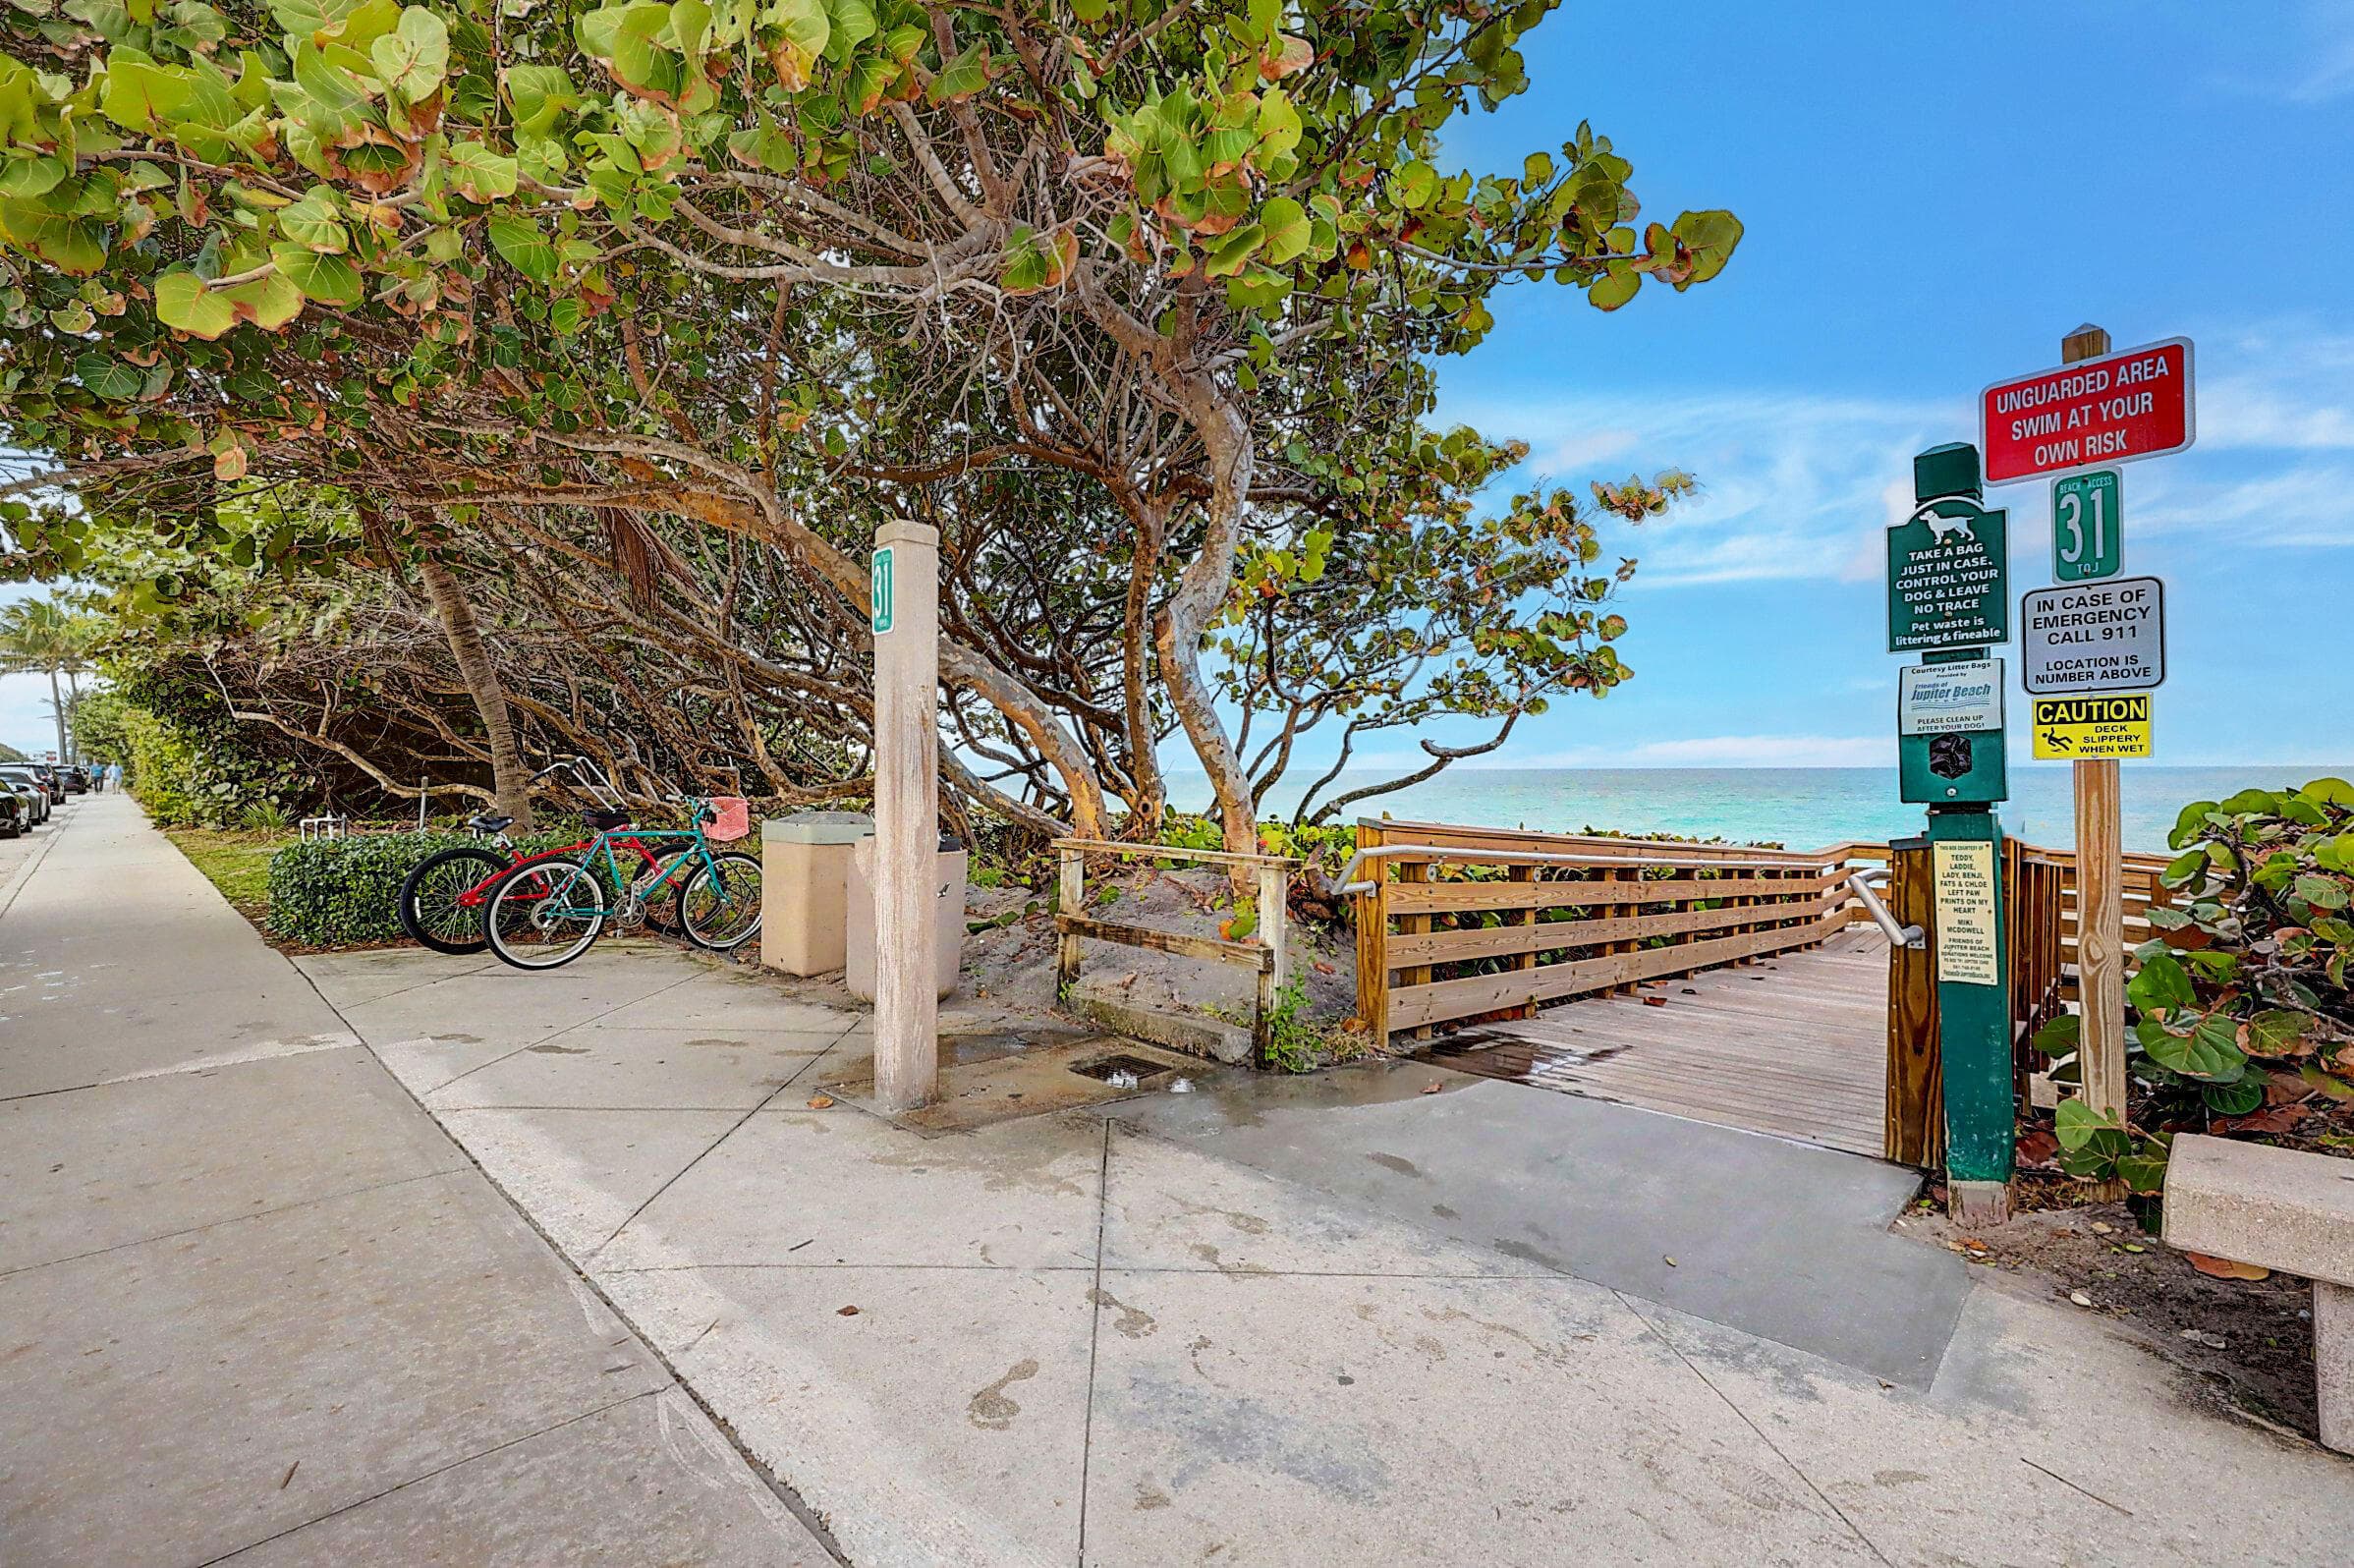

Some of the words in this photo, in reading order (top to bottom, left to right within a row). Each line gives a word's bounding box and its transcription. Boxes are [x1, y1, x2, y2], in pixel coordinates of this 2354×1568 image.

[1996, 370, 2109, 414] UNGUARDED
[2116, 356, 2169, 387] AREA
[2012, 412, 2061, 441] SWIM
[2067, 405, 2092, 429] AT
[2099, 393, 2153, 421] YOUR
[2034, 439, 2079, 466] OWN
[2086, 429, 2127, 457] RISK
[2060, 482, 2081, 494] BEACH
[2087, 476, 2112, 488] ACCESS
[2059, 488, 2104, 562] 31
[1909, 549, 1941, 561] TAKE
[1944, 548, 1953, 557] A
[1956, 543, 1983, 555] BAG
[1901, 564, 1933, 576] JUST
[1937, 561, 1950, 571] IN
[1953, 556, 1992, 569] CASE.
[1896, 575, 1957, 589] CONTROL
[1961, 569, 1998, 581] YOUR
[874, 562, 889, 618] 31
[1905, 590, 1932, 602] DOG
[1935, 589, 1945, 598] &
[1949, 584, 1990, 597] LEAVE
[1914, 604, 1933, 614] NO
[1937, 599, 1979, 611] TRACE
[2037, 599, 2054, 613] IN
[2062, 593, 2112, 610] CASE
[2120, 589, 2146, 603] OF
[1912, 622, 1930, 632] Pet
[1934, 618, 1969, 629] waste
[1974, 616, 1984, 626] is
[2033, 606, 2151, 629] EMERGENCY
[1896, 633, 1941, 645] littering
[1942, 631, 1951, 641] &
[1953, 628, 2000, 640] fineable
[2047, 630, 2094, 645] CALL
[2102, 625, 2137, 640] 911
[2046, 657, 2119, 671] LOCATION
[2125, 655, 2138, 665] IS
[2035, 671, 2094, 684] NUMBER
[2100, 667, 2151, 680] ABOVE
[1911, 688, 1951, 701] Jupiter
[1953, 683, 1991, 697] Beach
[2038, 699, 2145, 723] CAUTION
[2083, 734, 2141, 743] SLIPPERY
[2118, 744, 2144, 752] WET
